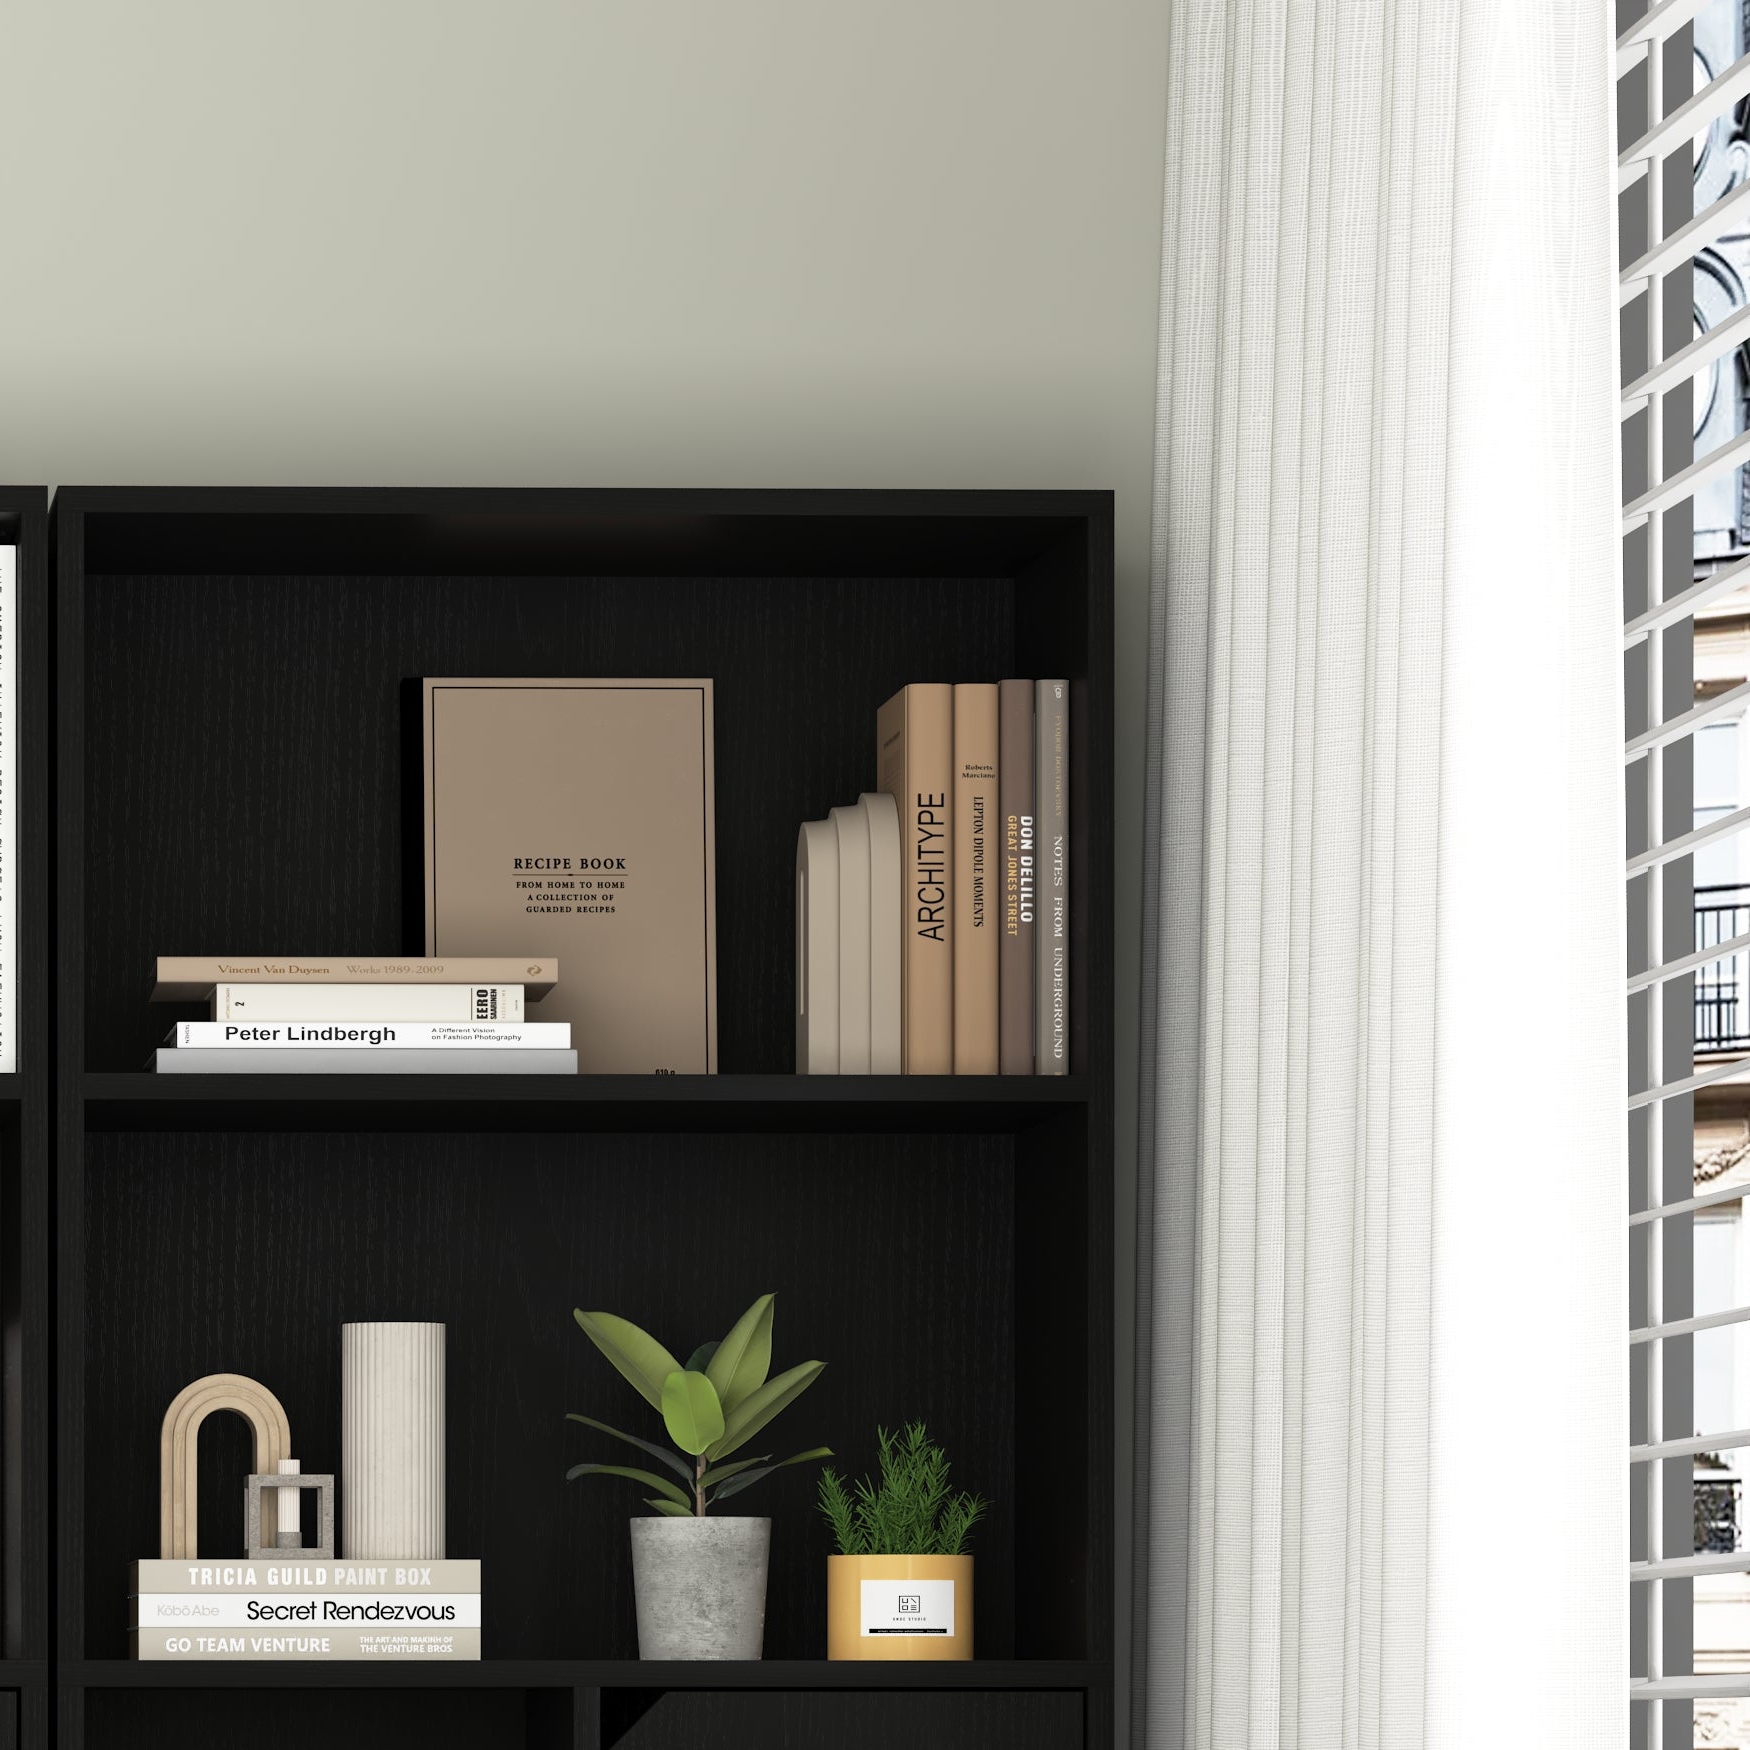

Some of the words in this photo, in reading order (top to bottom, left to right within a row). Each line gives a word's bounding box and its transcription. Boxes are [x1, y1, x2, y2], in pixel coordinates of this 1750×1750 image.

[964, 763, 993, 771] Roberts
[973, 796, 984, 835] LEPTON
[1007, 815, 1018, 852] GREAT
[1020, 816, 1033, 850] DON
[513, 858, 572, 870] RECIPE
[580, 858, 626, 870] BOOK
[917, 792, 945, 942] ARCHITYPE
[973, 838, 984, 873] DIPOLE
[1053, 836, 1063, 887] NOTES
[516, 881, 543, 889] FROM
[547, 881, 575, 889] HOME
[579, 881, 592, 889] TO
[597, 881, 625, 889] HOME
[1007, 855, 1018, 891] JONES
[973, 876, 984, 928] MOMENTS
[1020, 856, 1033, 923] DELILLO
[1007, 894, 1018, 936] STREET
[1053, 896, 1063, 937] FROM
[218, 964, 260, 975] Vincent
[263, 965, 286, 975] Van
[288, 965, 330, 977] Duysen
[346, 964, 381, 975] Works
[476, 989, 488, 1019] EERO
[1053, 947, 1063, 1059] UNDERGROUND
[225, 1026, 282, 1041] Peter
[287, 1026, 396, 1045] Lindbergh
[188, 1567, 257, 1586] TRICIA
[267, 1567, 327, 1586] GUILD
[334, 1567, 388, 1586] PAINT
[395, 1567, 432, 1586] BOX
[192, 1604, 220, 1617] Abe
[247, 1601, 317, 1621] Secret
[323, 1601, 456, 1621] Rendezvous
[165, 1637, 191, 1653] GO
[196, 1637, 246, 1653] TEAM
[251, 1637, 331, 1653] VENTURE
[359, 1636, 374, 1644] THE
[375, 1636, 389, 1644] ART
[392, 1636, 408, 1644] AND
[443, 1636, 453, 1644] OF
[360, 1645, 378, 1653] THE
[381, 1645, 425, 1653] VENTURE
